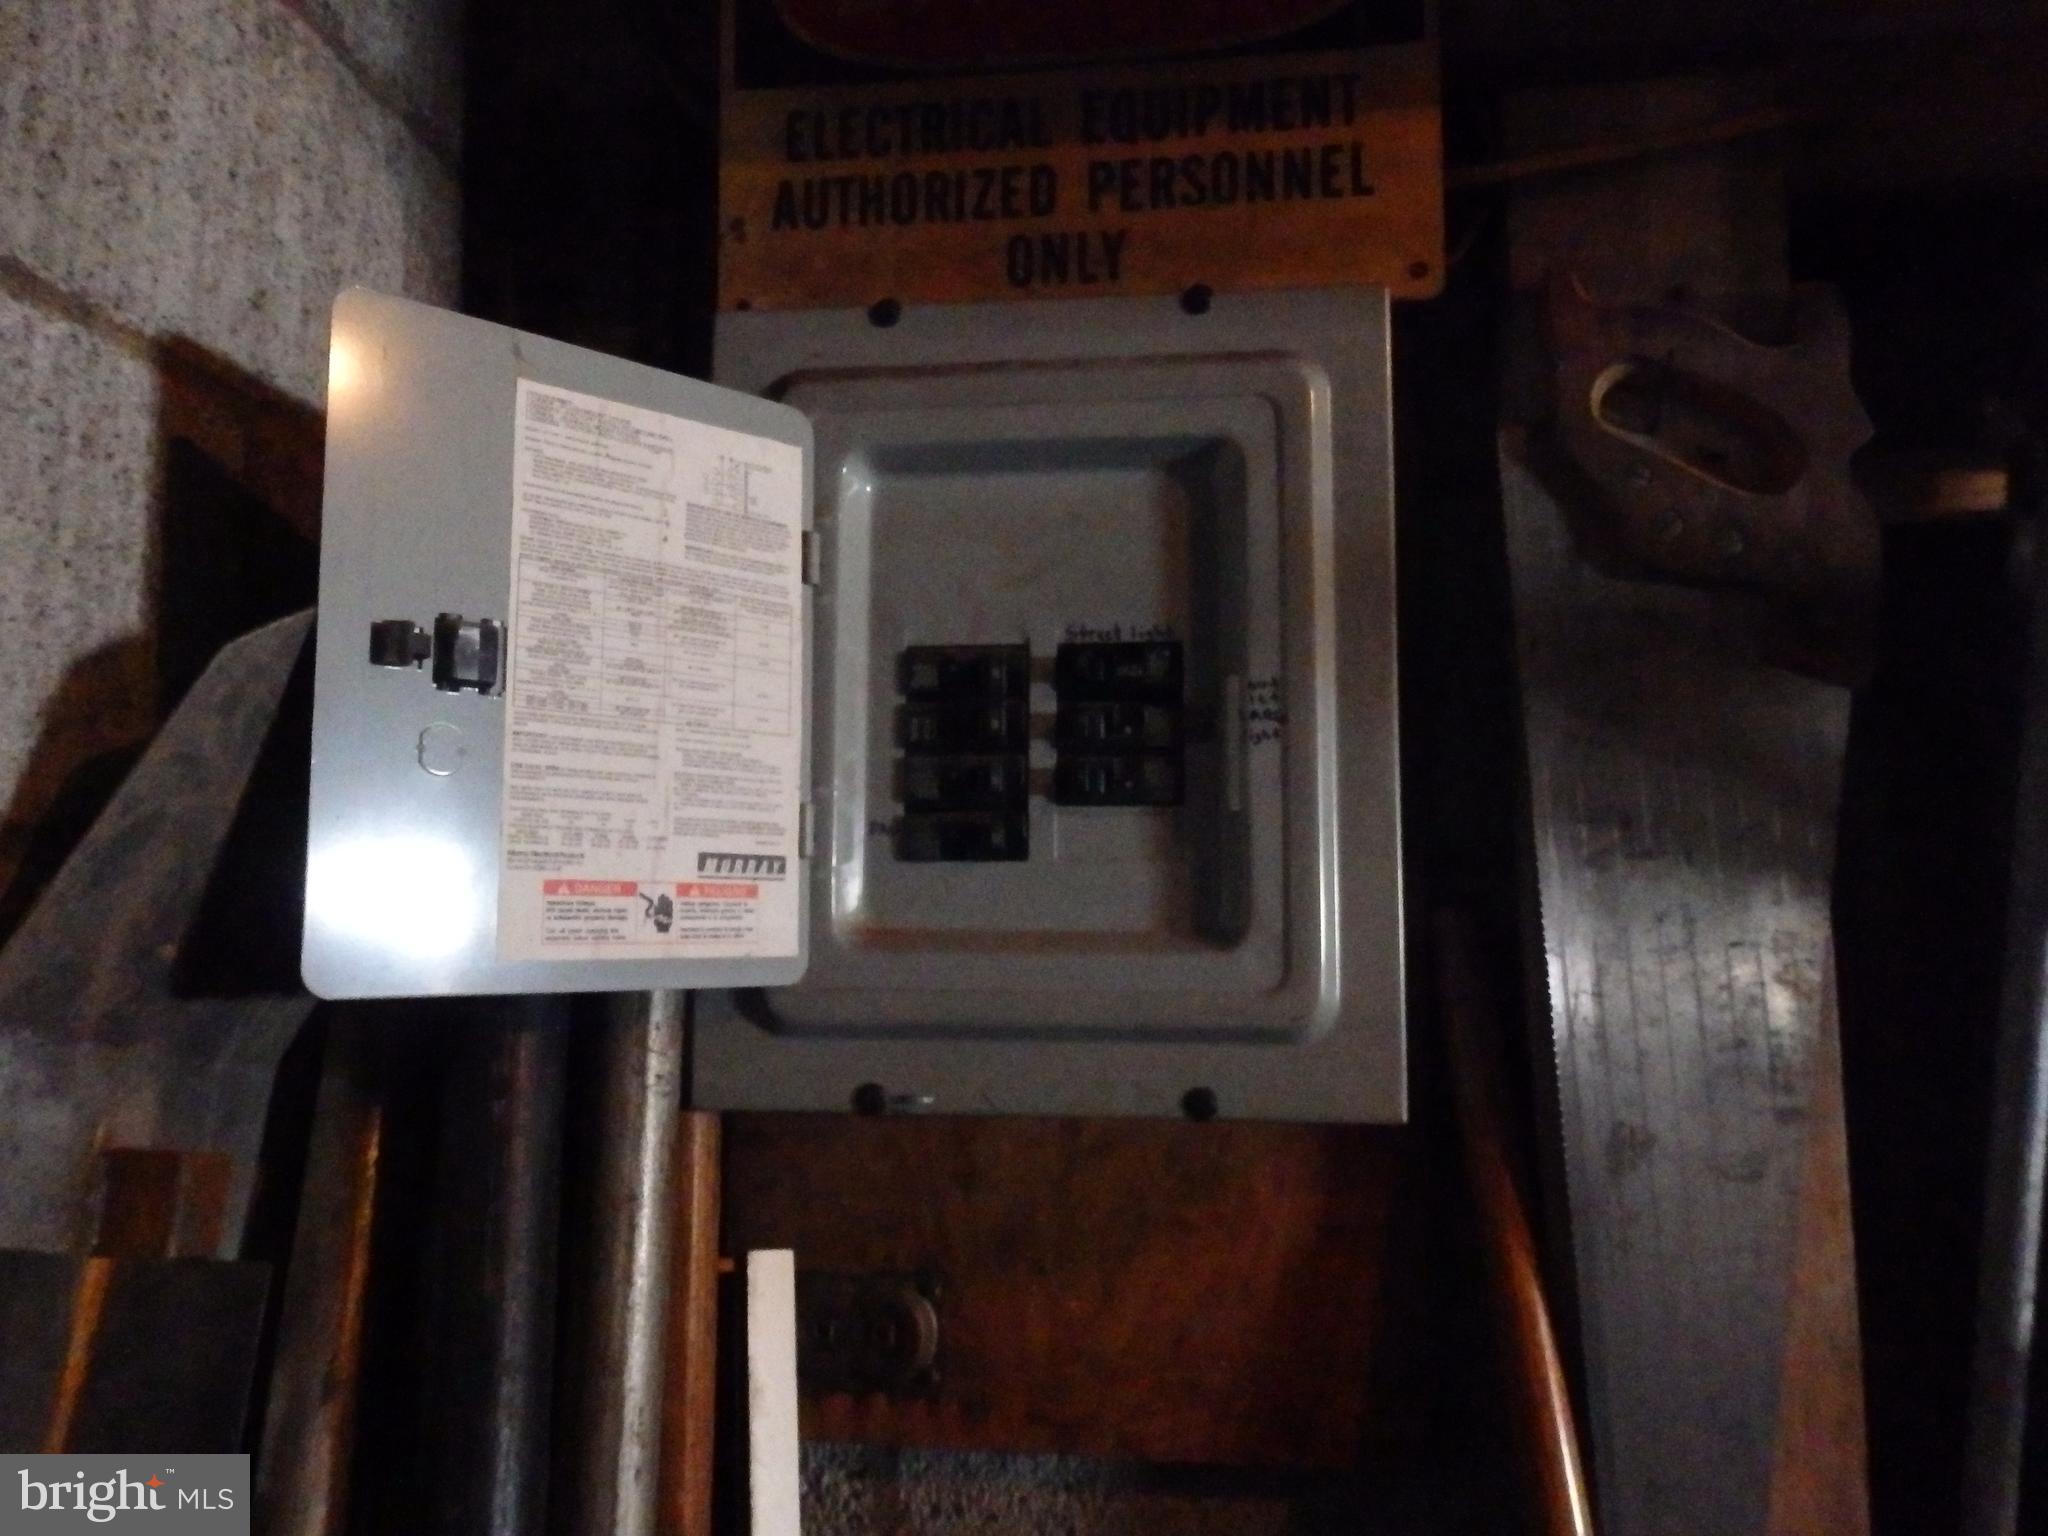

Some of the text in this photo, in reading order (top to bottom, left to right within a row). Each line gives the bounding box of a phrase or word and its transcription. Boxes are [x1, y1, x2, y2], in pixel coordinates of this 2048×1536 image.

[786, 74, 1362, 161] ELECTRICAL EQUIPMENT
[772, 142, 1374, 231] AUTHORIZED PERSONNEL
[1007, 231, 1127, 288] ONLY
